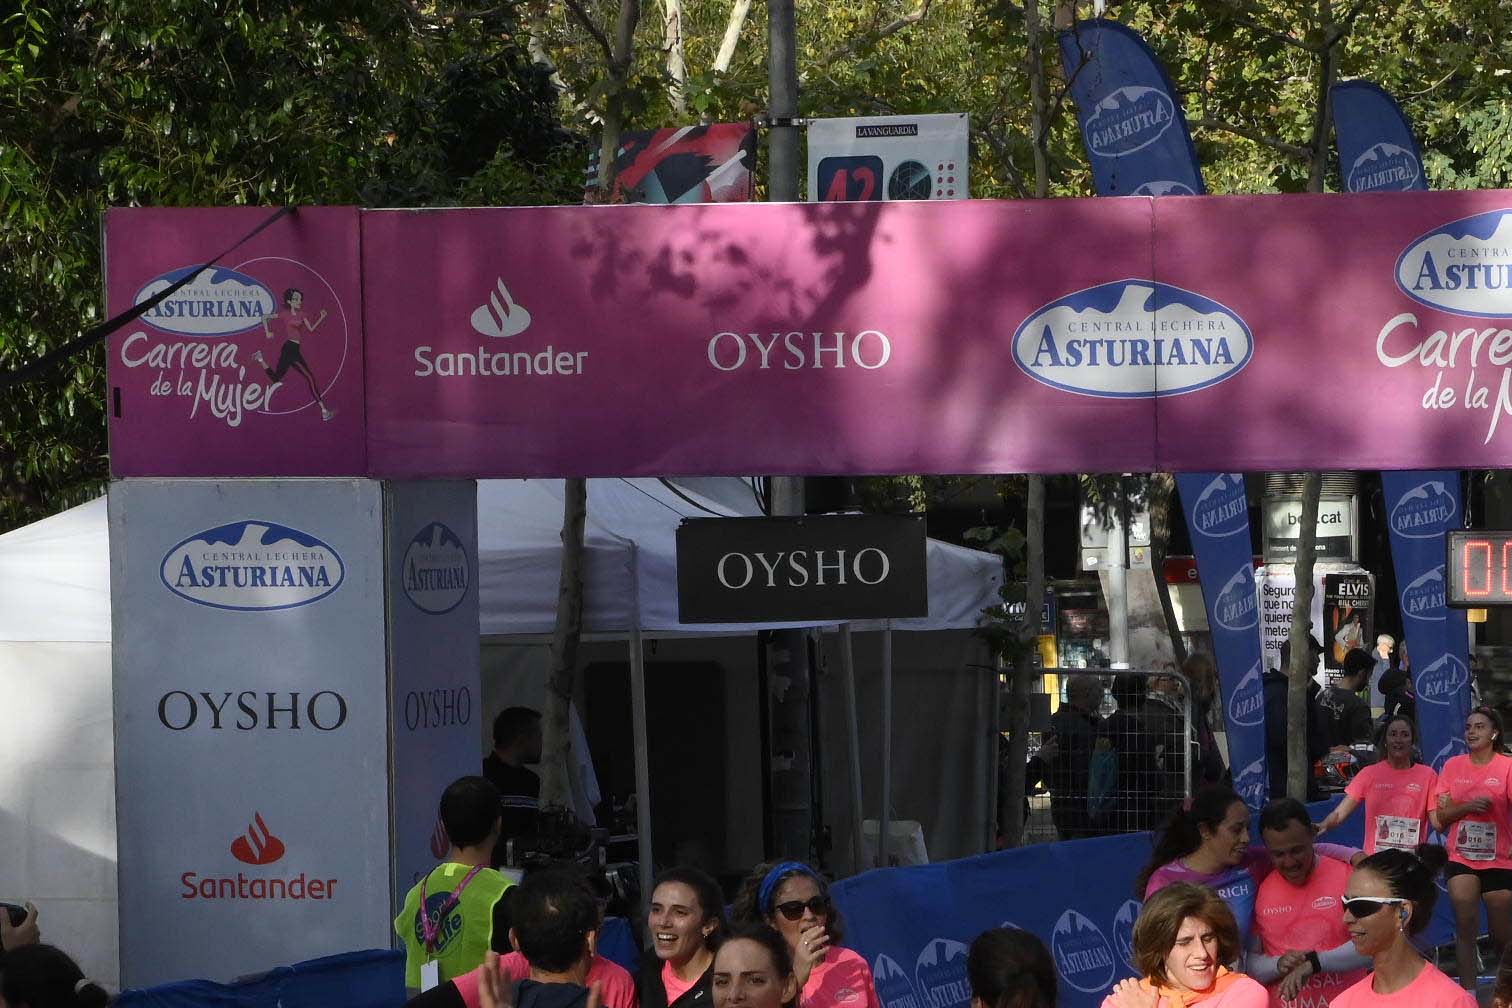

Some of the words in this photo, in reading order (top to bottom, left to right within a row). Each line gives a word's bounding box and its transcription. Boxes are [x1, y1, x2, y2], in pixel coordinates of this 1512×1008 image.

[858, 127, 868, 137] LA
[868, 125, 917, 136] VANGUARDIA
[145, 291, 265, 319] ASTURIANA
[1068, 320, 1144, 333] CENTRAL
[1151, 319, 1226, 332] LECHERA
[121, 331, 239, 368] Carrera
[414, 345, 589, 378] Santander
[707, 330, 891, 371] OYSHO
[1031, 324, 1235, 368] ASTURIANA
[150, 370, 172, 396] de
[177, 370, 193, 396] la
[189, 366, 283, 427] Mujer
[1422, 371, 1457, 410] de
[1464, 371, 1489, 410] la
[175, 554, 331, 588] ASTURIANA
[203, 552, 261, 561] CENTRAL
[266, 551, 324, 561] LECHERA
[717, 547, 890, 589] OYSHO
[408, 561, 466, 592] ASTURIANA
[1338, 583, 1368, 596] ELVIS
[1264, 600, 1280, 612] que
[158, 690, 347, 731] OYSHO
[405, 686, 471, 731] OYSHO
[181, 872, 338, 899] Santander
[1058, 943, 1113, 976] ASTURIANA
